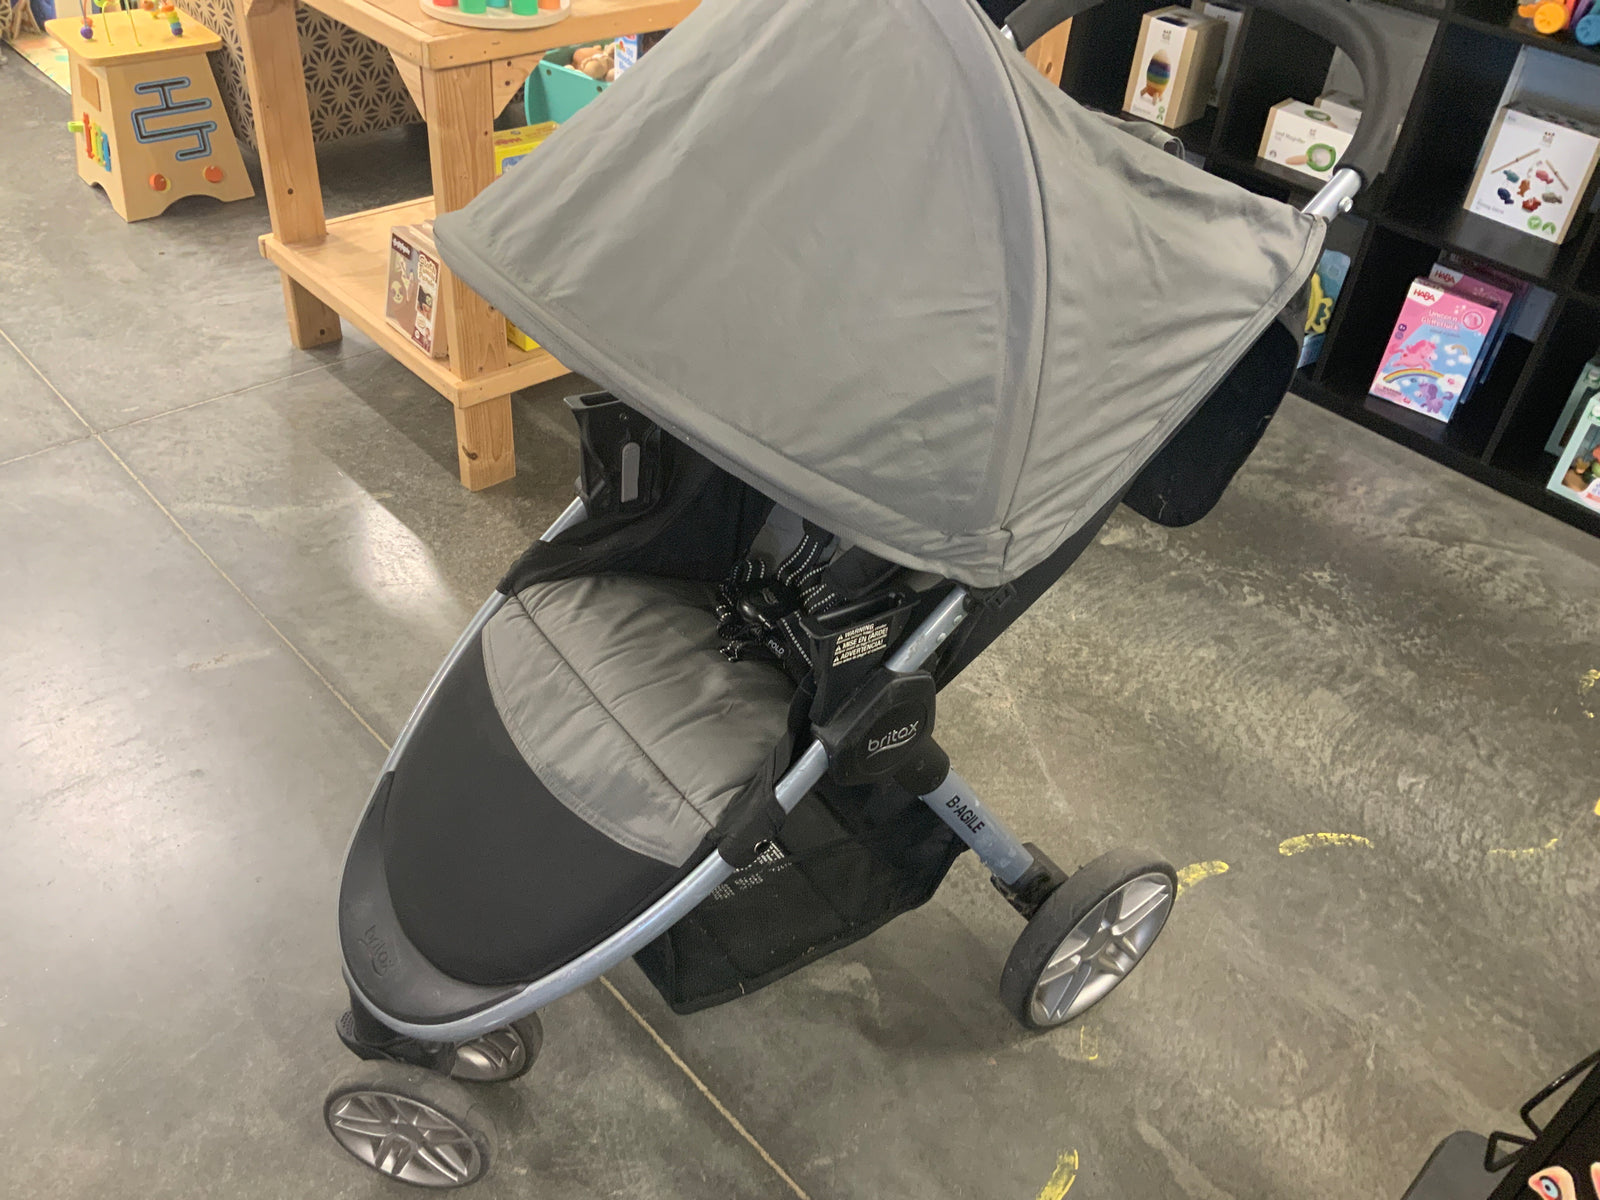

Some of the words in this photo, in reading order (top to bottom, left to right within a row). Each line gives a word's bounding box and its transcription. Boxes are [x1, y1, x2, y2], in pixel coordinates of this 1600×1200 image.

[1434, 269, 1456, 285] HABA
[1412, 288, 1436, 302] HABA
[844, 623, 875, 638] WARNING
[768, 639, 785, 655] FOLD
[857, 635, 868, 644] EN
[866, 720, 919, 754] britax
